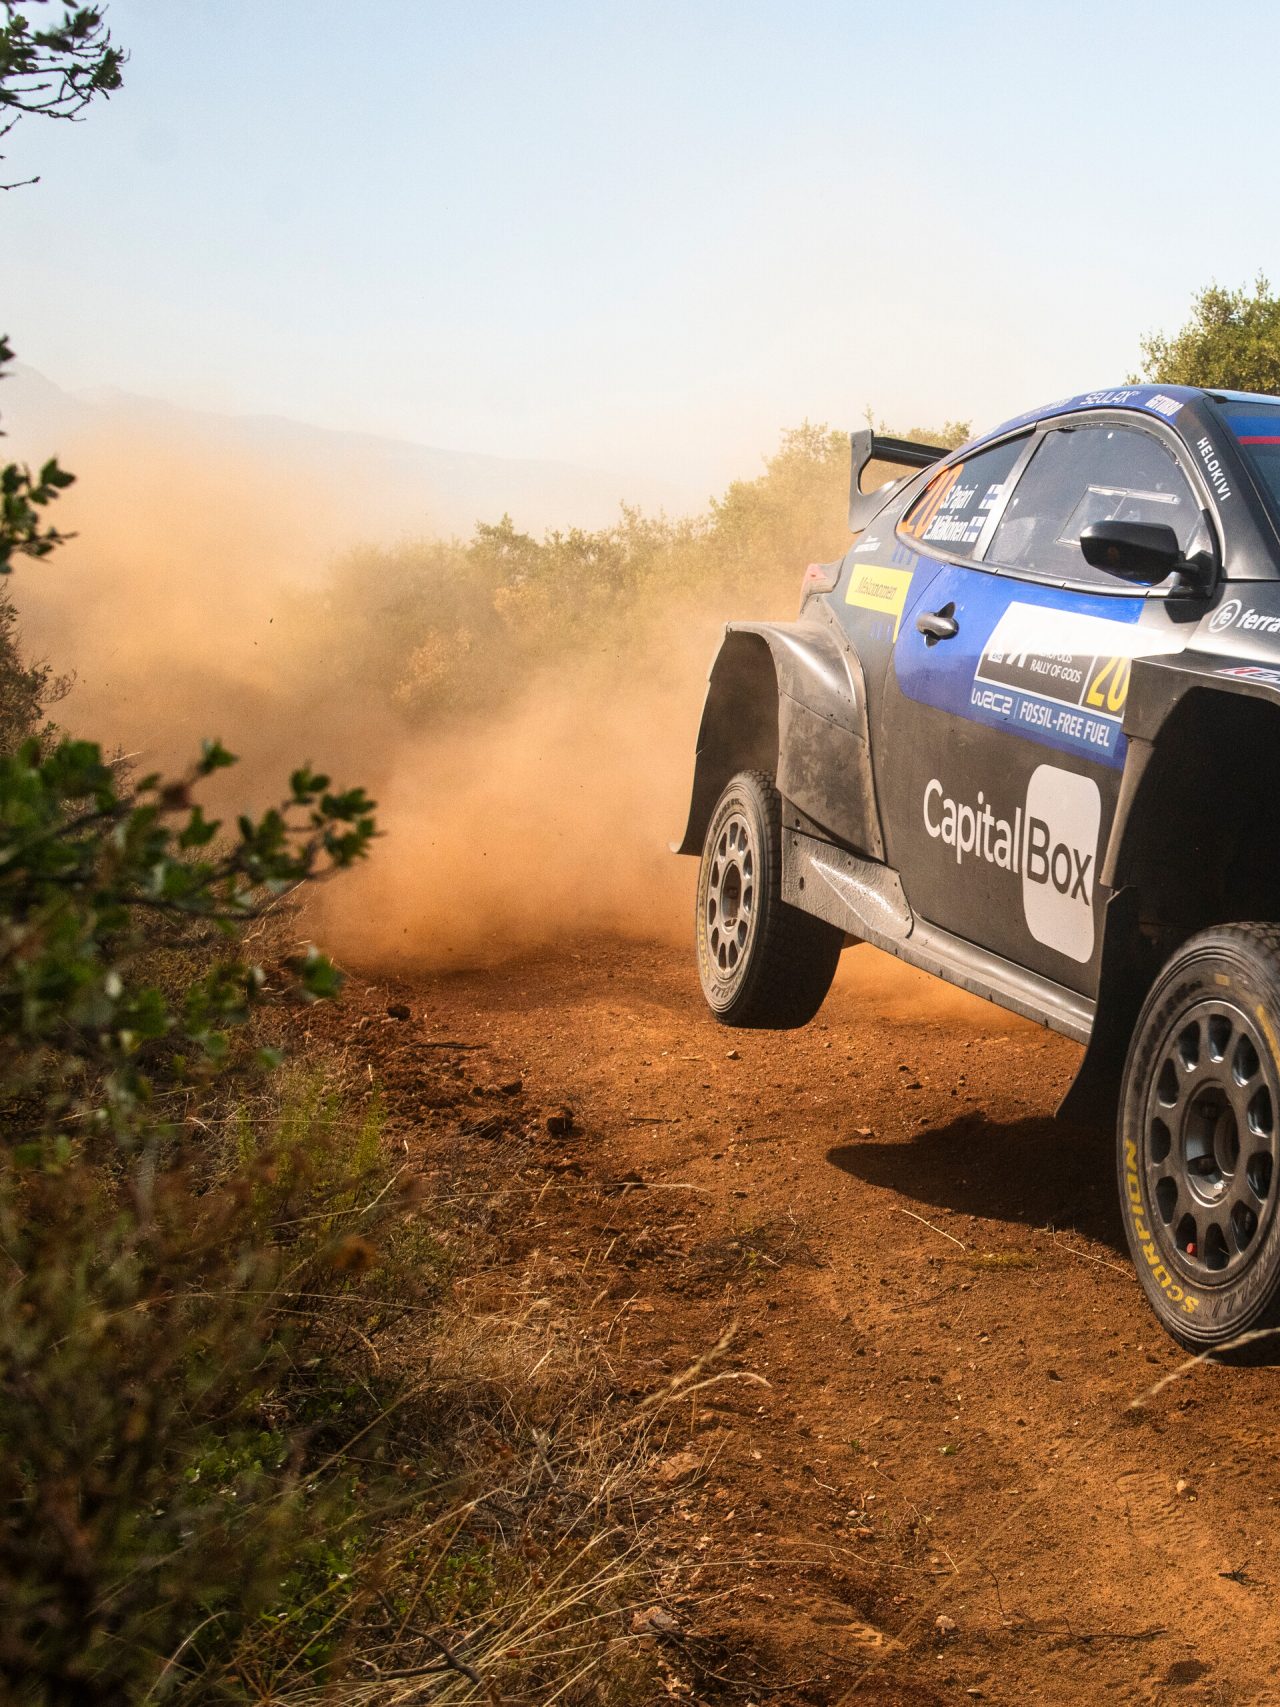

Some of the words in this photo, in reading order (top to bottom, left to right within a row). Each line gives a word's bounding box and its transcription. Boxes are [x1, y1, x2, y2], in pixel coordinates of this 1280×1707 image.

[1197, 437, 1232, 502] HELOKIVI
[1029, 659, 1051, 675] RALLY
[1050, 664, 1063, 678] OF
[1060, 667, 1083, 684] GODS
[1019, 701, 1084, 738] FOSSIL-FREE
[1083, 720, 1110, 747] FUEL
[1125, 1137, 1200, 1314] SCORPION
